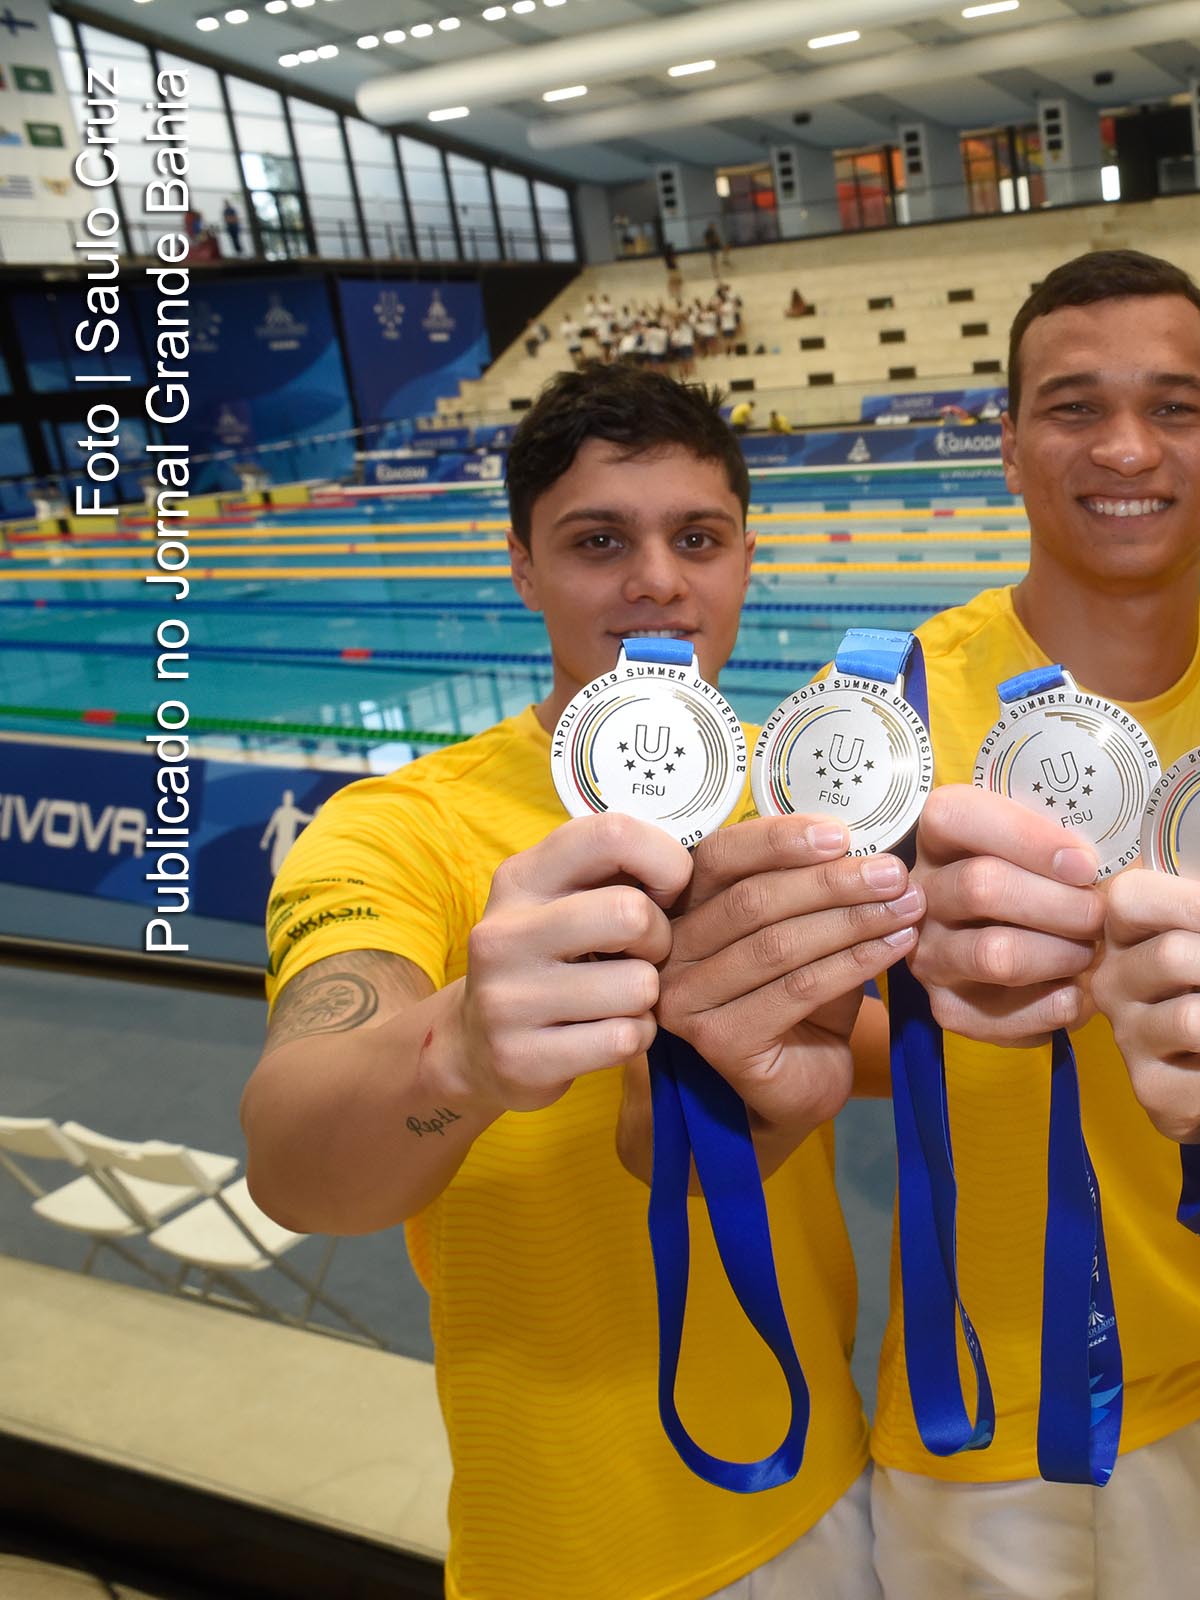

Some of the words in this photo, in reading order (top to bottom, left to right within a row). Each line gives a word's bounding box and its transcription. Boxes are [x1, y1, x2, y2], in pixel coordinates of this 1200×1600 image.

[553, 704, 579, 758] NAPOLI
[583, 673, 618, 699] 2019
[626, 666, 687, 681] SUMMER
[693, 679, 747, 773] UNIVERSIADE
[755, 707, 786, 758] NAPOLI
[792, 683, 826, 705] 2019
[833, 679, 889, 697] SUMMER
[892, 696, 932, 793] UNIVERSIADE
[981, 722, 1007, 755] 2019
[1010, 693, 1066, 720] SUMMER
[1075, 694, 1158, 769] UNIVERSIADE
[631, 783, 666, 797] FISU
[818, 790, 850, 807] FISU
[1147, 765, 1181, 816] NAPOLI
[0, 793, 147, 859] IVOVA
[680, 830, 704, 847] 019
[1060, 809, 1094, 828] FISU
